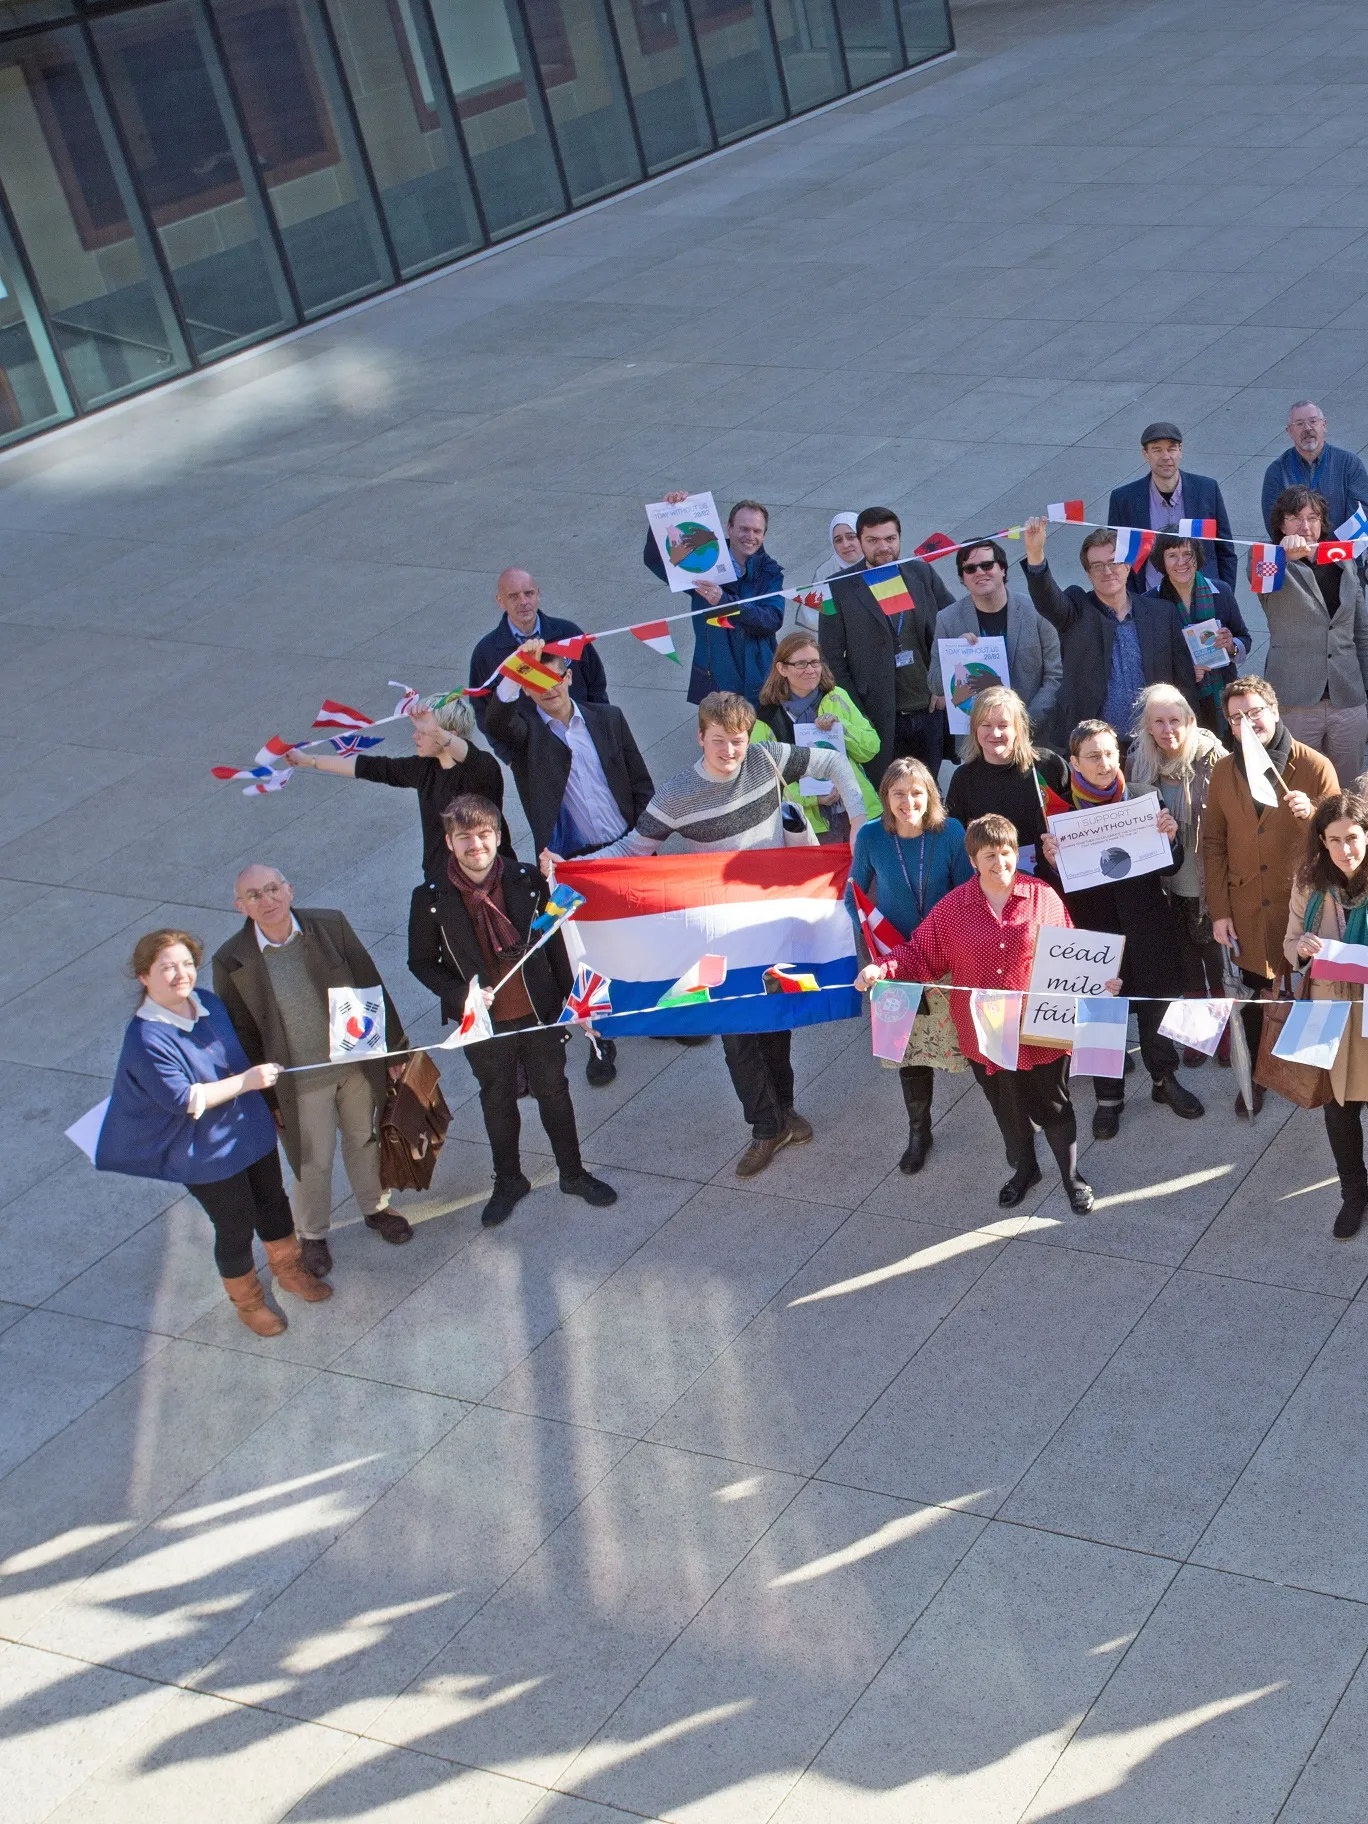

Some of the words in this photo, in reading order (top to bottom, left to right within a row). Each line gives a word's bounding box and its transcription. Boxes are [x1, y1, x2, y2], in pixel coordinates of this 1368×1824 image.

[1060, 813, 1154, 842] #1DAYWITHOUTUS
[1083, 809, 1130, 827] SUPPORT
[1049, 942, 1116, 964] céad
